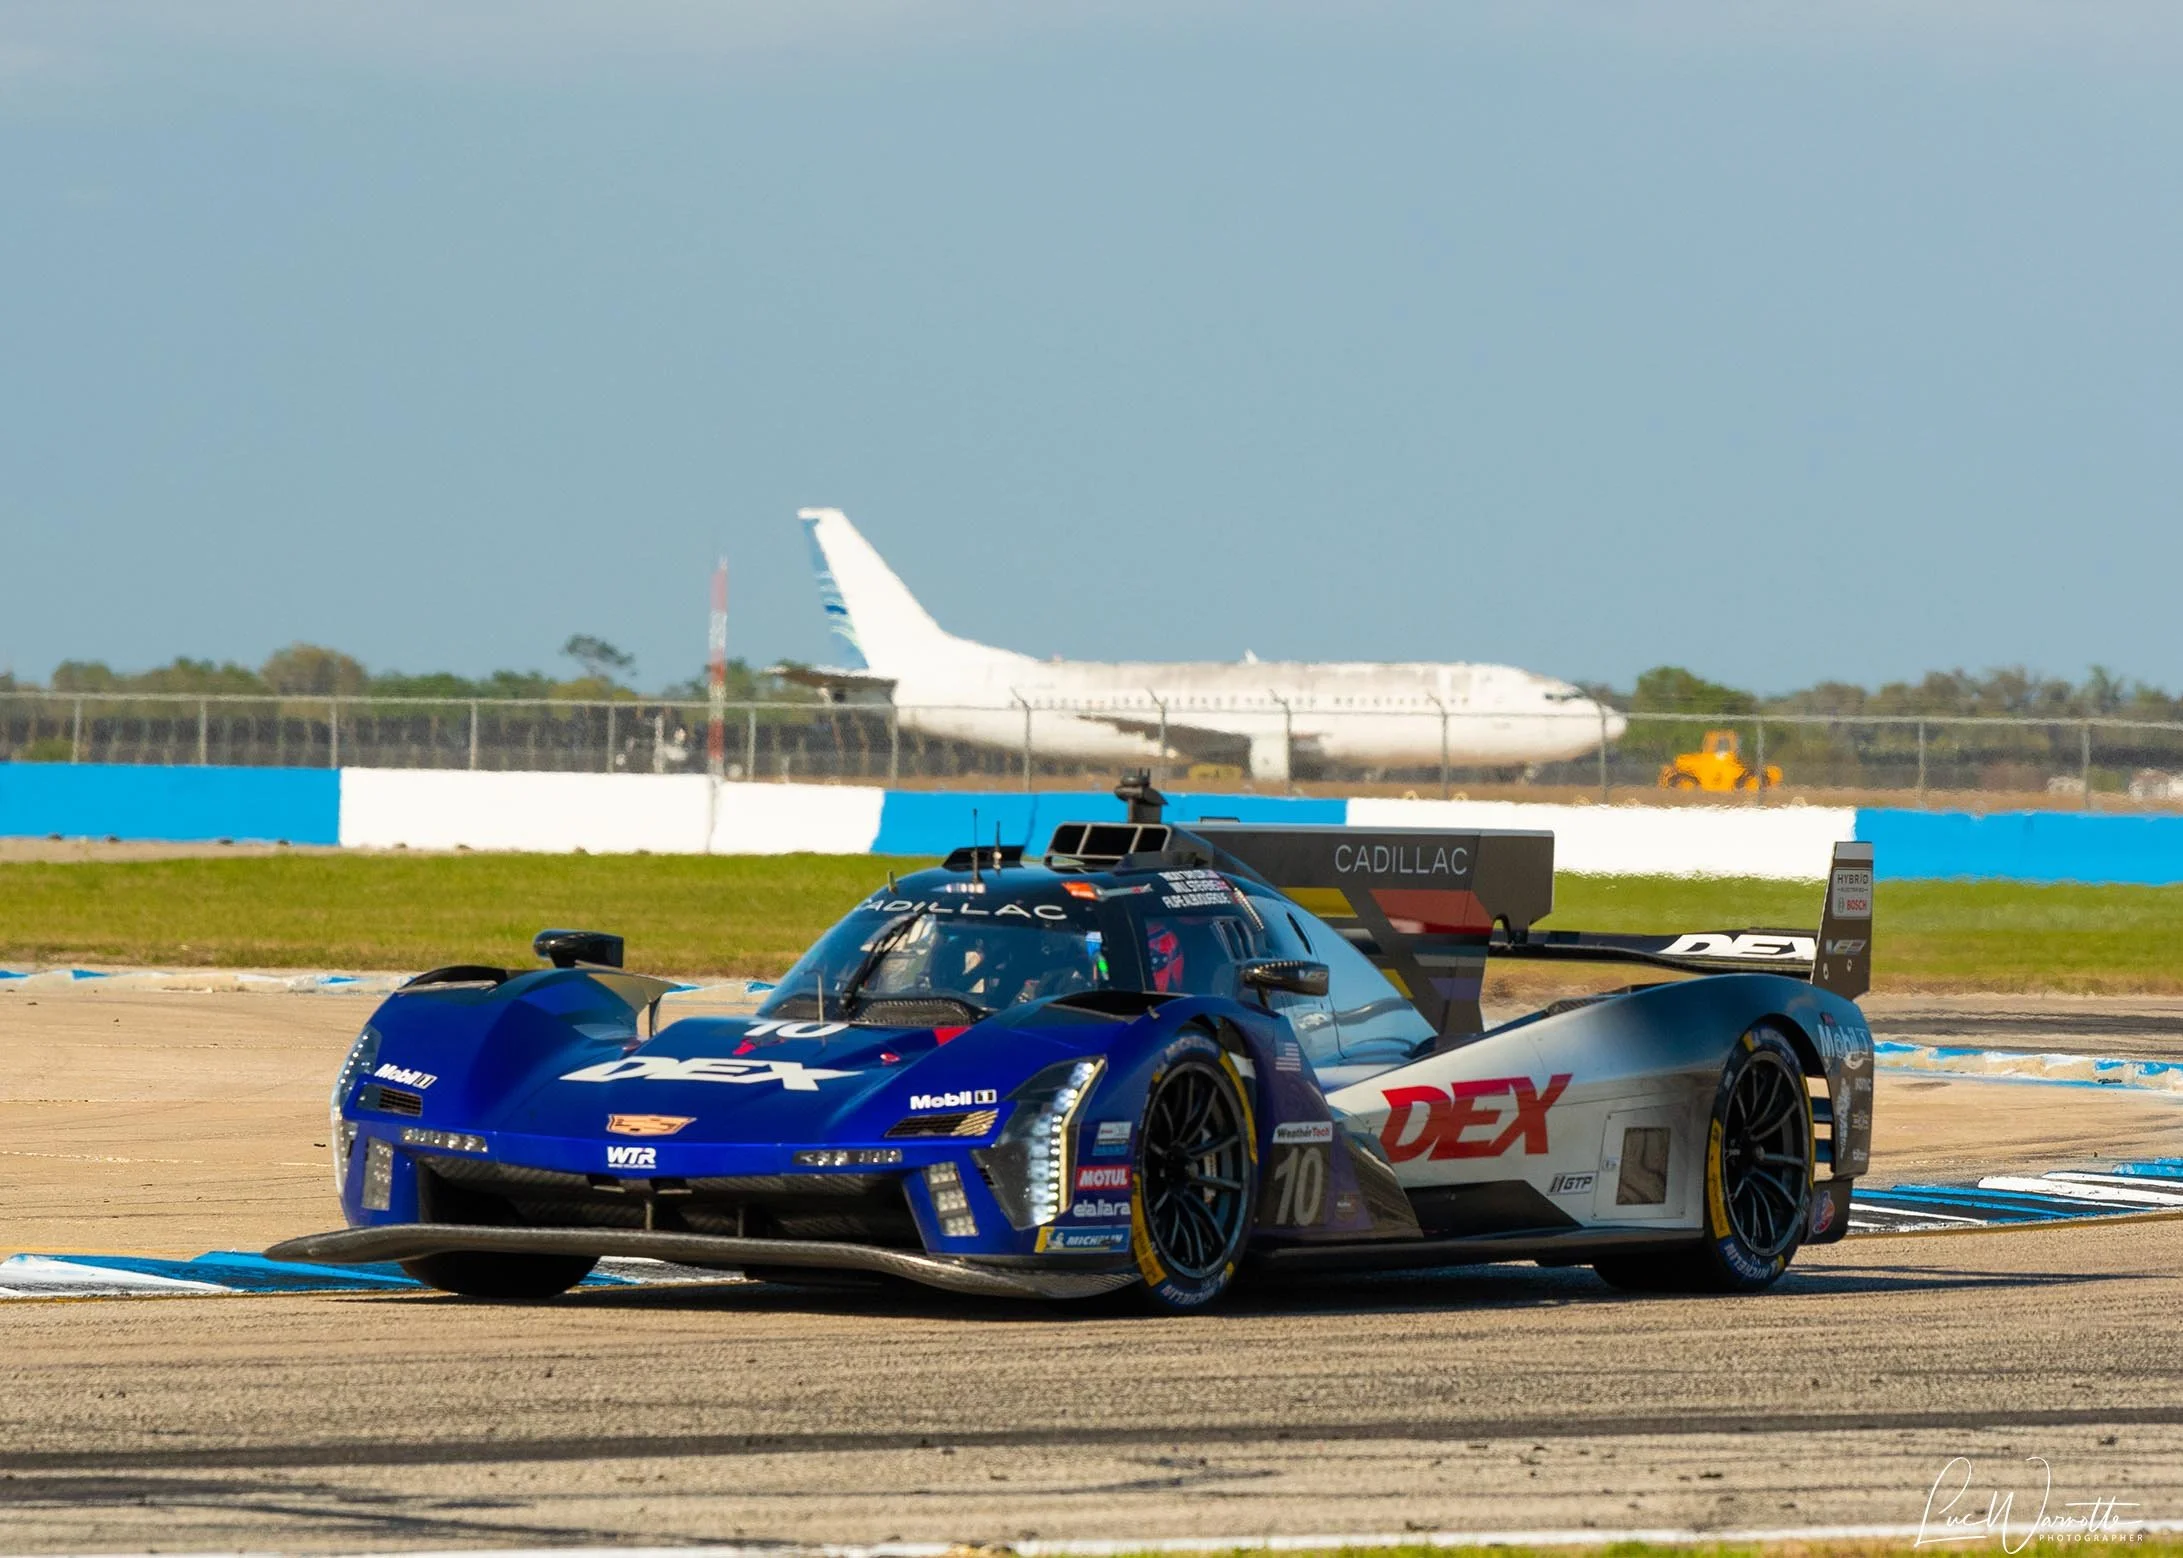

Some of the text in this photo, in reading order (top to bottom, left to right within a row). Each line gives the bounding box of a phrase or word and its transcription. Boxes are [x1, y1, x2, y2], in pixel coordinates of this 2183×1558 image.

[1335, 844, 1467, 875] CADILLAC
[1837, 874, 1868, 885] HYBRID
[1846, 900, 1867, 911] BOSCH
[1817, 1024, 1859, 1058] Mobil
[374, 1063, 422, 1085] Mobil
[559, 1056, 864, 1091] DEX
[910, 1091, 972, 1109] Mobil
[1379, 1073, 1573, 1164] DEX
[1277, 1126, 1329, 1138] WeatherTech
[607, 1146, 656, 1164] WTR
[1079, 1168, 1127, 1187] MOTUL
[1274, 1147, 1323, 1226] 10
[1563, 1176, 1593, 1190] GTP
